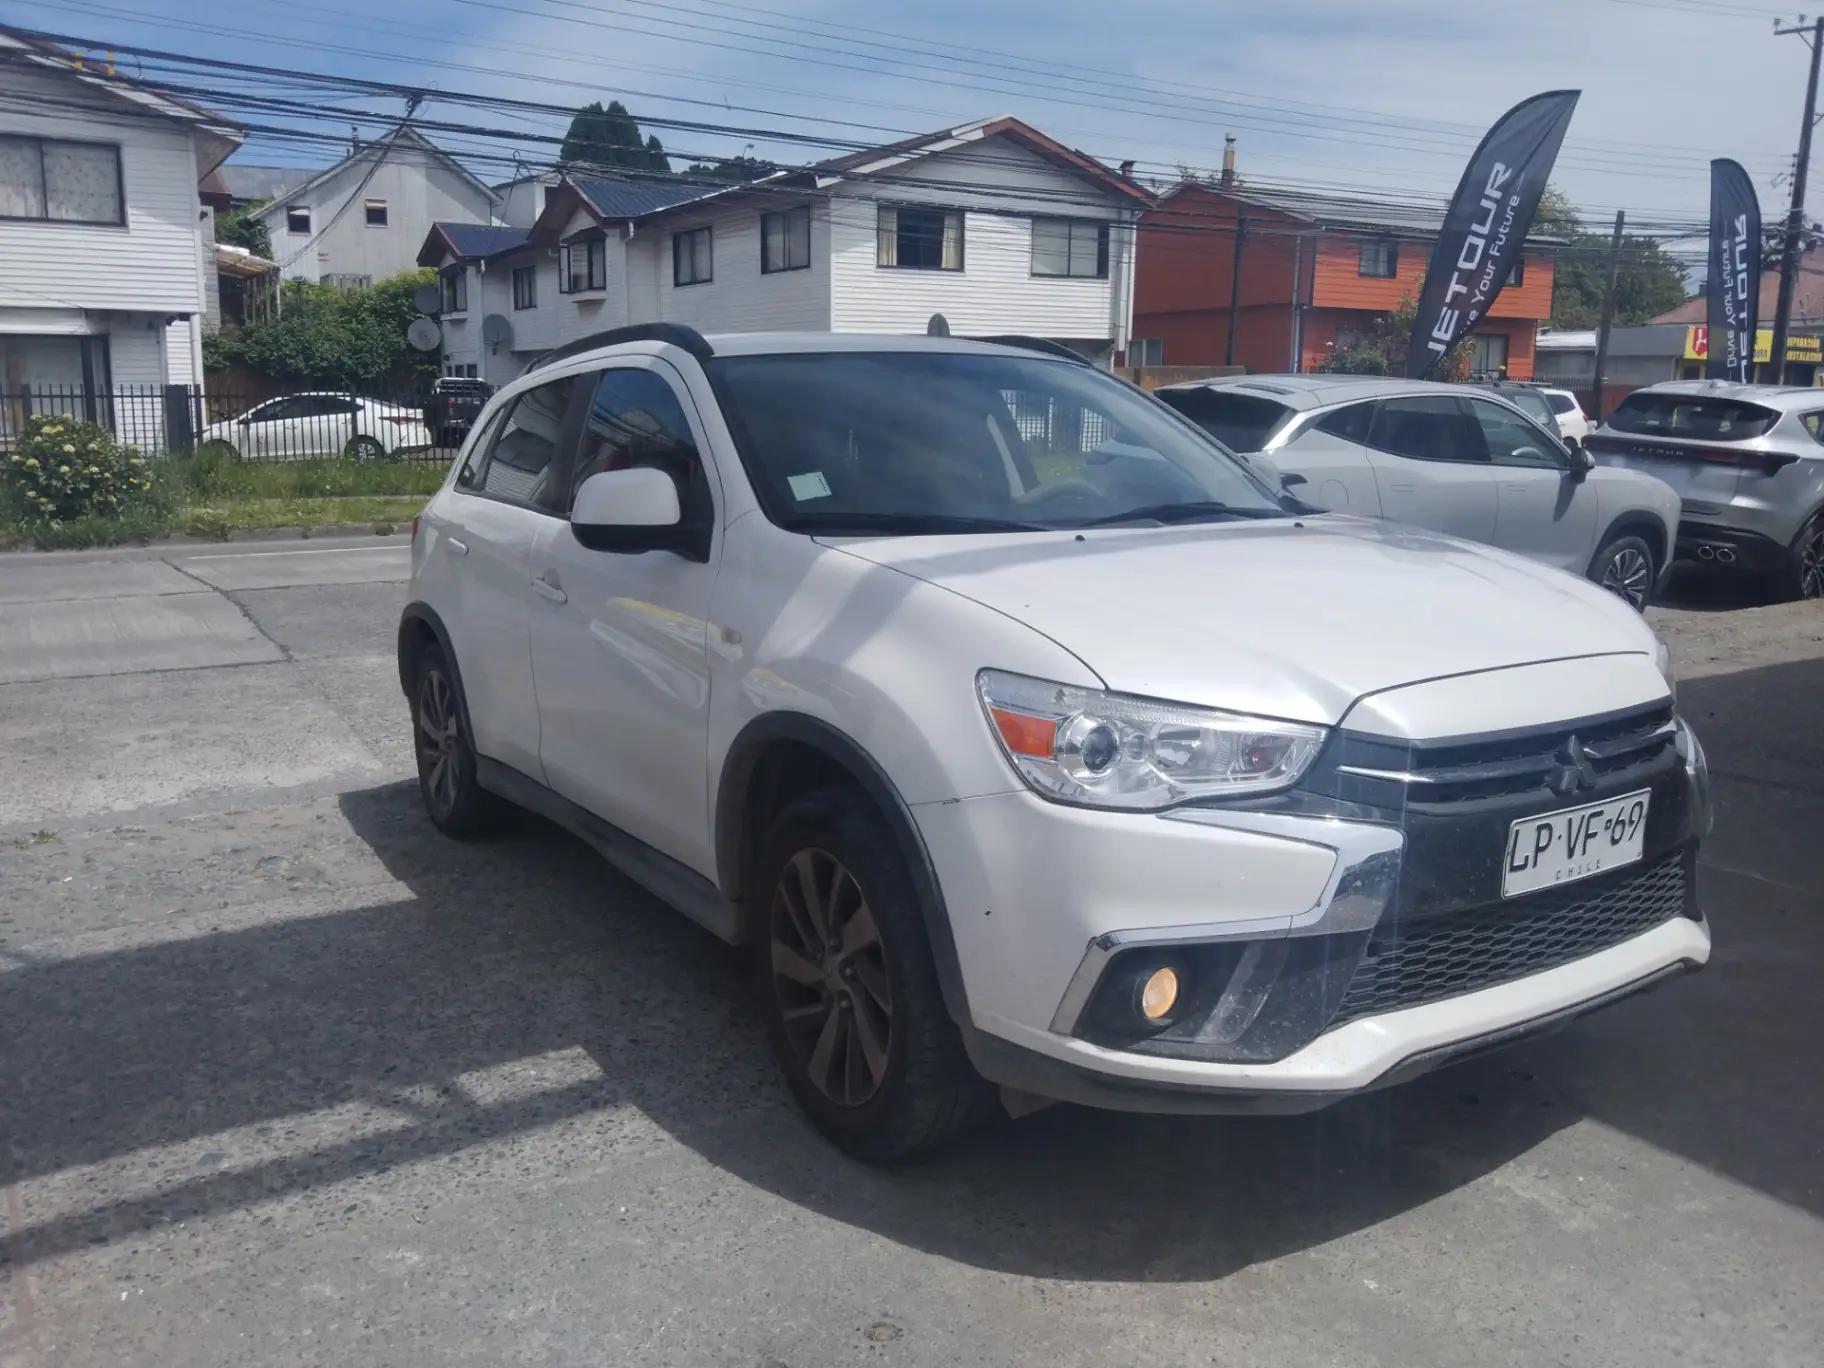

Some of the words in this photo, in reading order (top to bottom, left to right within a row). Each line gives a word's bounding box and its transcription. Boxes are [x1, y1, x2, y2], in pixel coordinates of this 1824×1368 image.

[1428, 162, 1512, 360] JETOUR
[1471, 262, 1496, 304] Your
[1490, 196, 1520, 256] Future
[1555, 859, 1601, 881] CHILE
